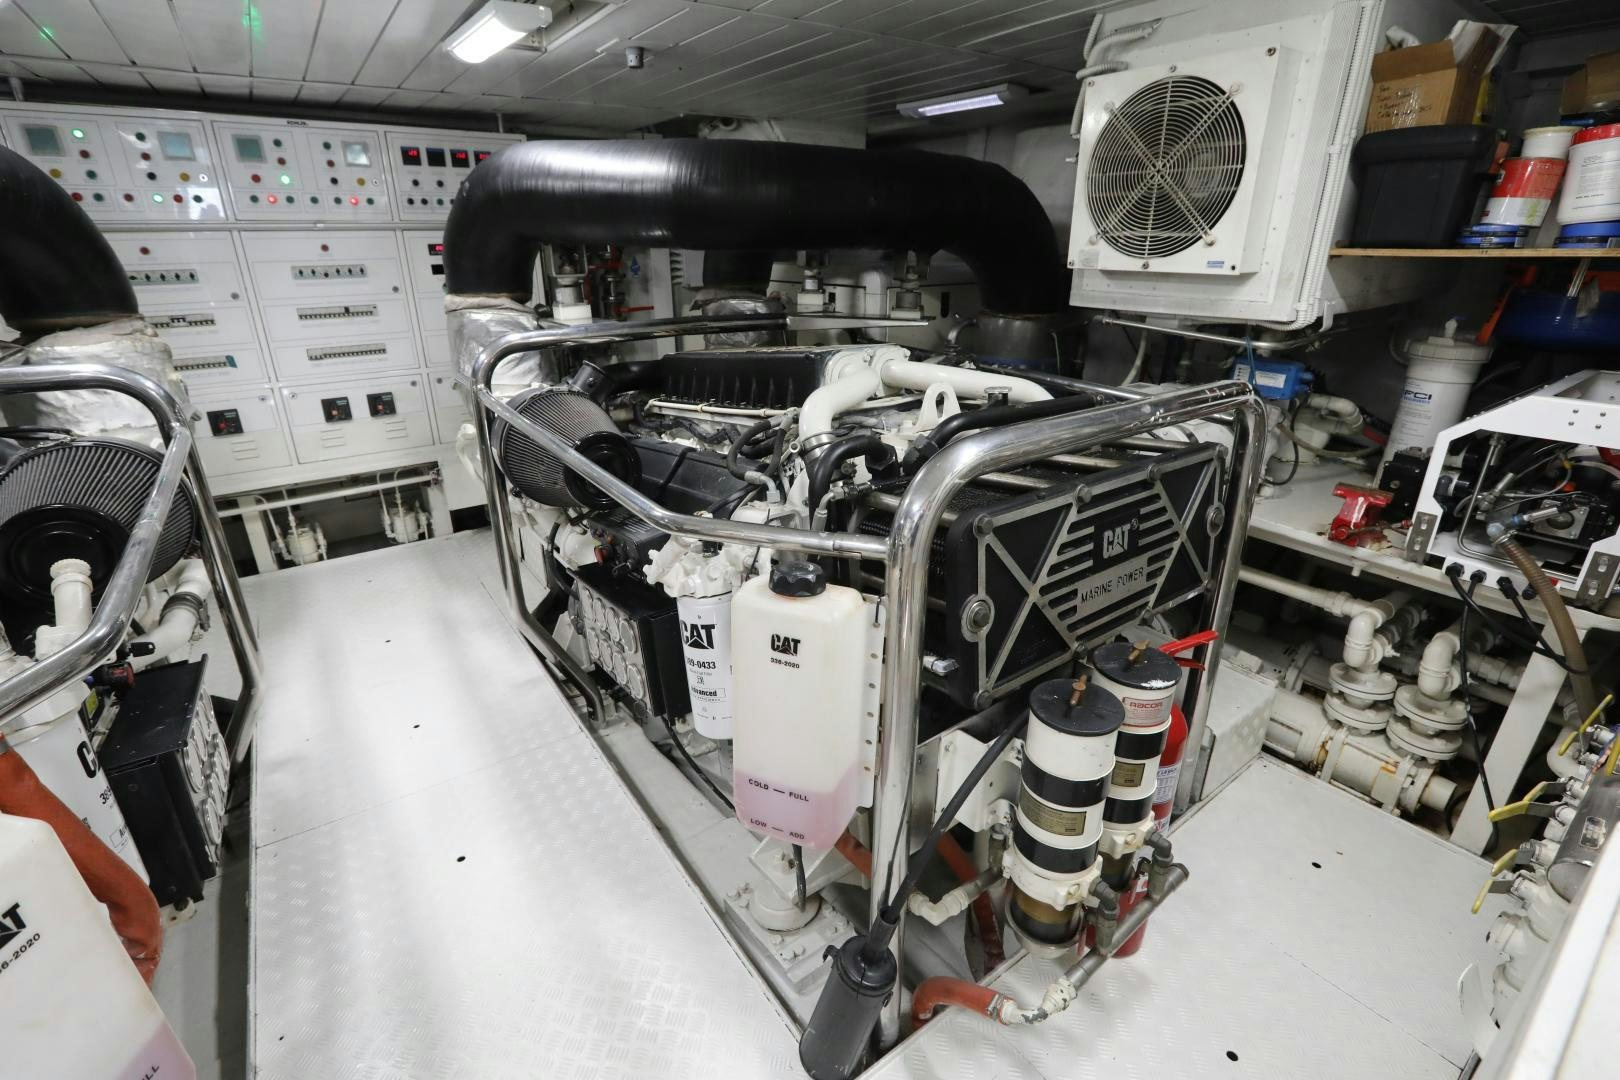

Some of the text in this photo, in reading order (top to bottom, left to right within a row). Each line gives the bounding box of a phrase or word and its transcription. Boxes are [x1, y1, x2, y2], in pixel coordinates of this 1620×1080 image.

[1404, 390, 1432, 400] PCI
[1081, 567, 1145, 604] MARINE POWER
[771, 633, 801, 656] CAT
[748, 778, 809, 802] COLD FULL
[750, 817, 805, 840] LOW ADD
[0, 932, 41, 974] 6-2020
